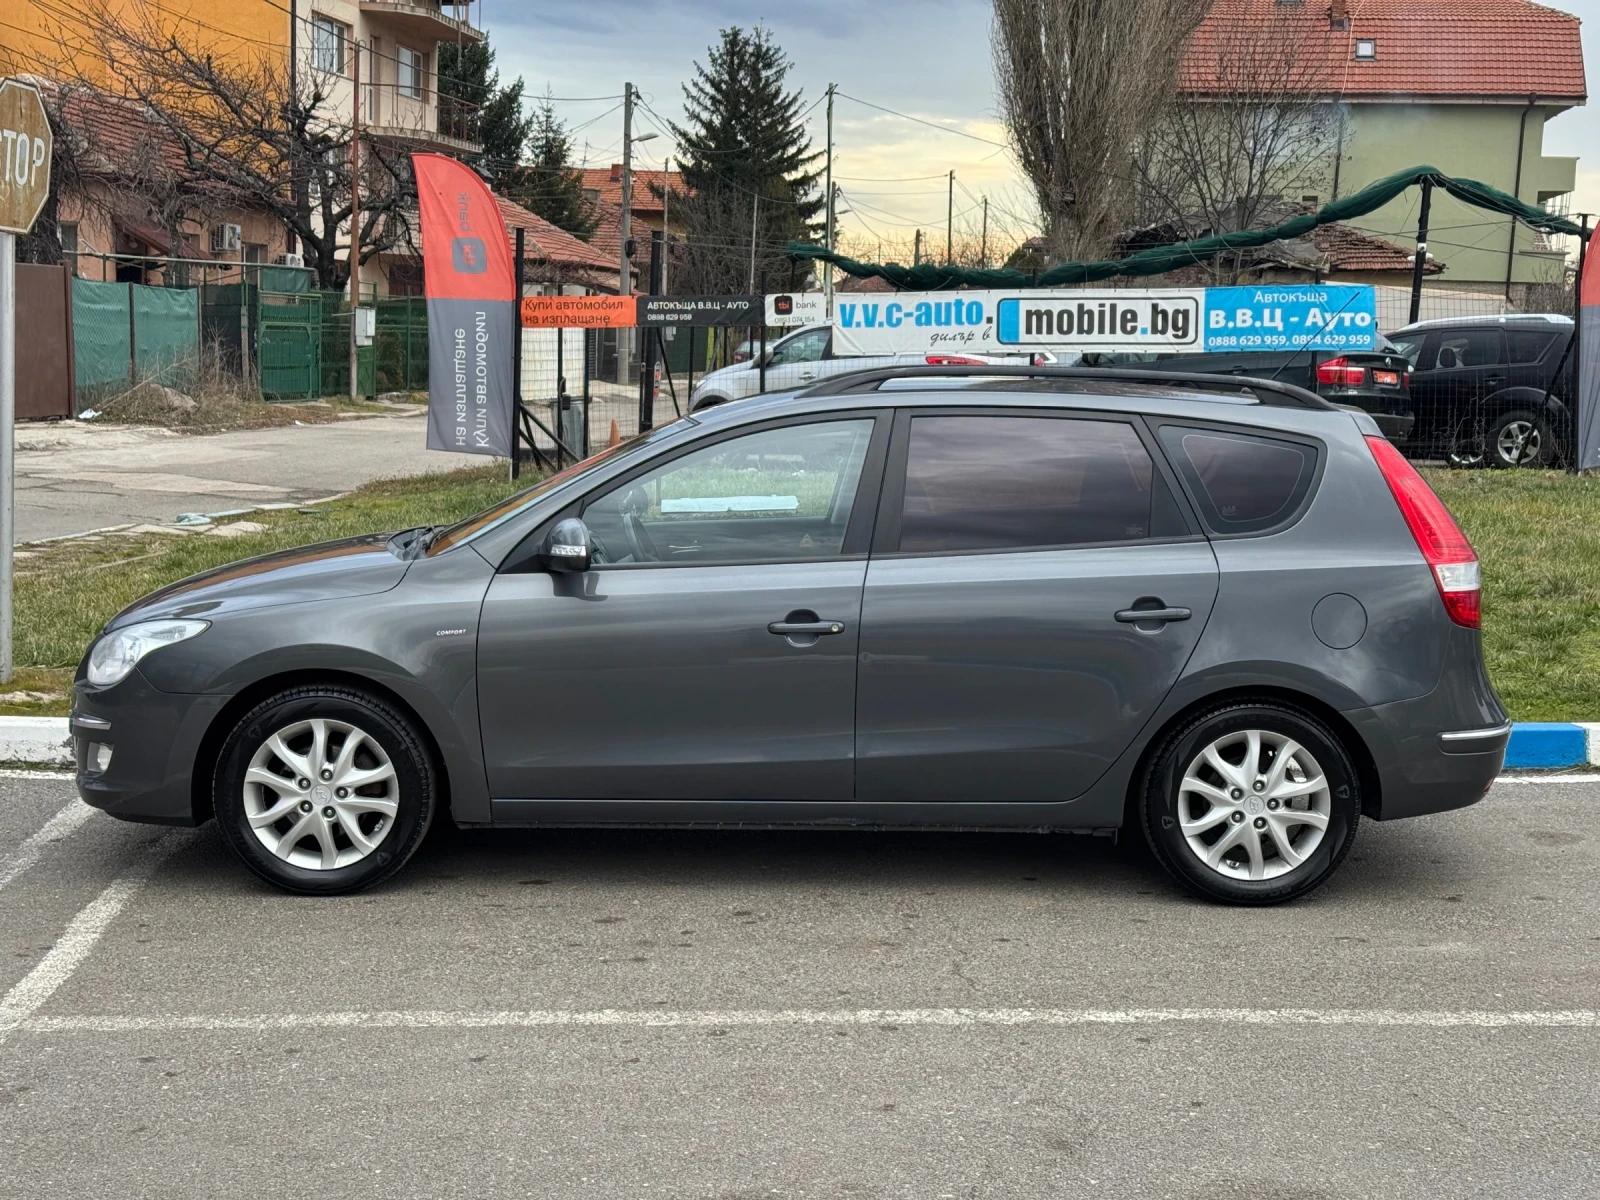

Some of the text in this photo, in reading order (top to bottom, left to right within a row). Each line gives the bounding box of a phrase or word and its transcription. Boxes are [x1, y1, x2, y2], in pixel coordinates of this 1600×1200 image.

[0, 129, 45, 187] TOP
[1254, 291, 1328, 304] Автокъща
[525, 300, 623, 312] Купи автомобил
[647, 301, 696, 311] АВТОКЪЩА
[698, 301, 720, 311] В.В.Ц
[727, 301, 749, 310] АУТО
[777, 301, 817, 310] tbi bank
[525, 315, 611, 325] на изплащане
[647, 313, 692, 321] 0888 629 959
[1025, 303, 1190, 339] mobile.bg
[1209, 308, 1284, 331] В.В.Ц
[1305, 308, 1371, 331] Ауто
[930, 326, 992, 347] дилър в
[1208, 335, 1371, 347] 0888 629 959, 0894 629 959
